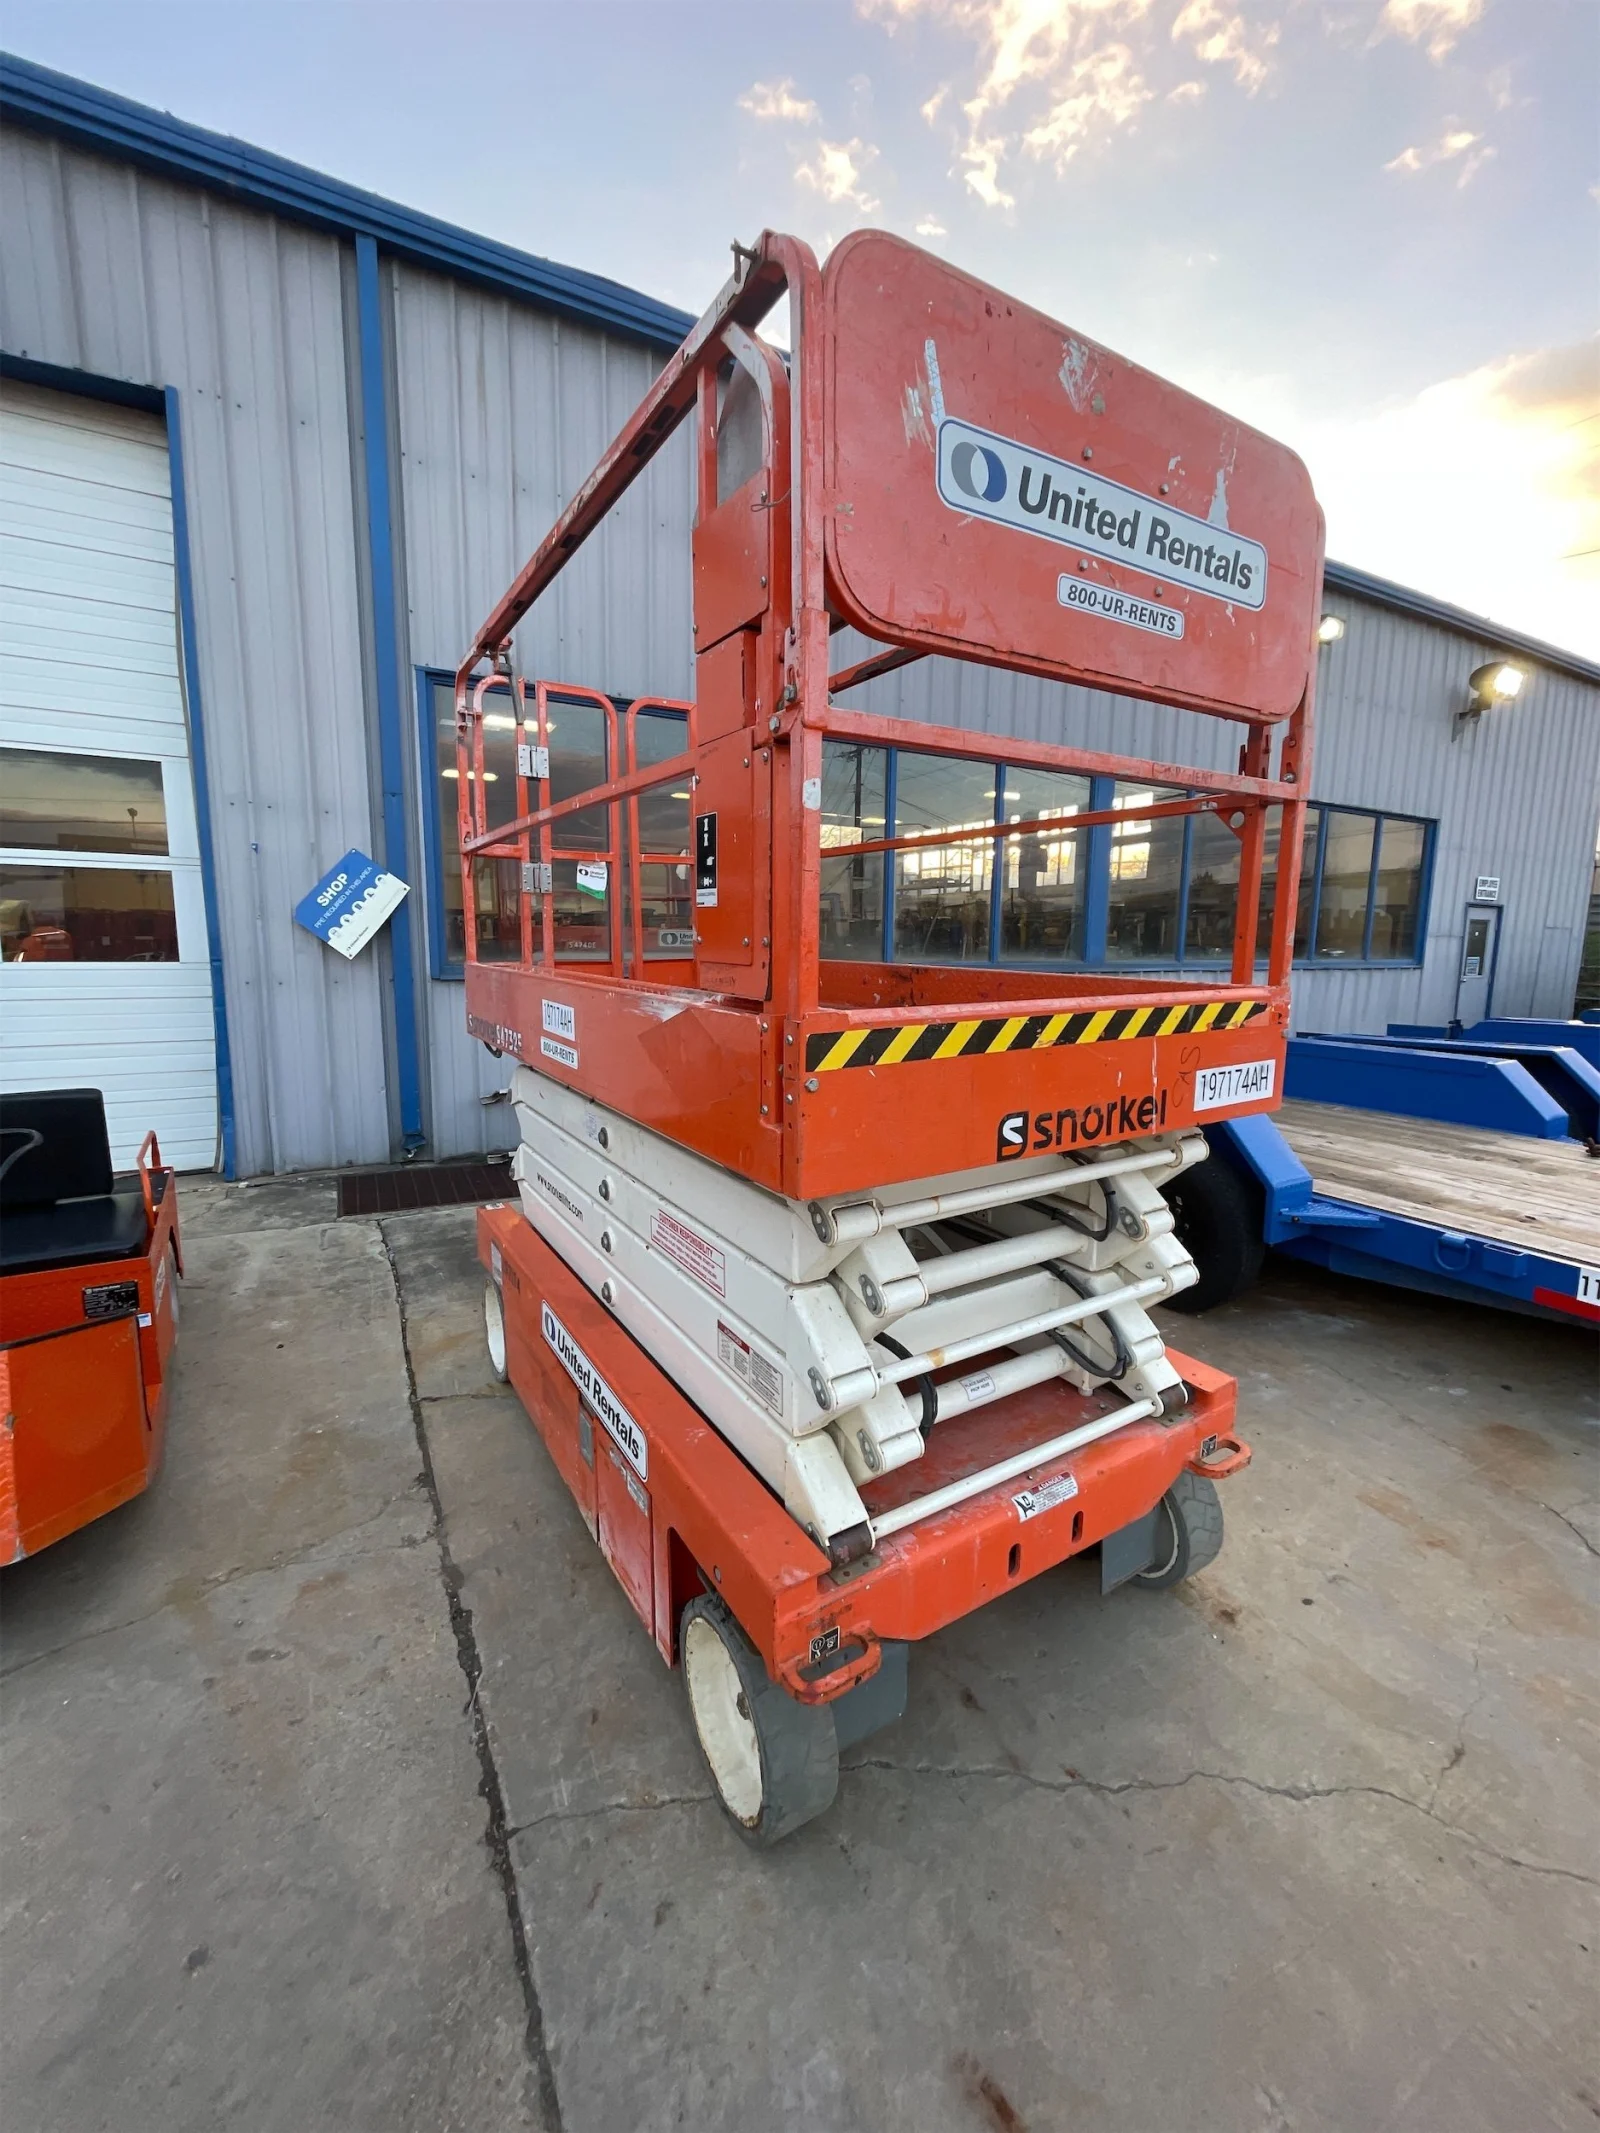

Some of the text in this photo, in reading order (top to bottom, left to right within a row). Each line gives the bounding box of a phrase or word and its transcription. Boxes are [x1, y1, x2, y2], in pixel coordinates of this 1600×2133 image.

[1018, 466, 1252, 590] United Rentals
[1067, 584, 1176, 632] 800-UR-RENTS
[316, 873, 348, 907] SHOP
[360, 867, 372, 881] AREA
[544, 1002, 572, 1034] 197174AH
[1200, 1064, 1270, 1102] 197174AH
[1033, 1089, 1168, 1150] snorkel
[557, 1328, 591, 1392] United
[593, 1377, 640, 1460] Rentals
